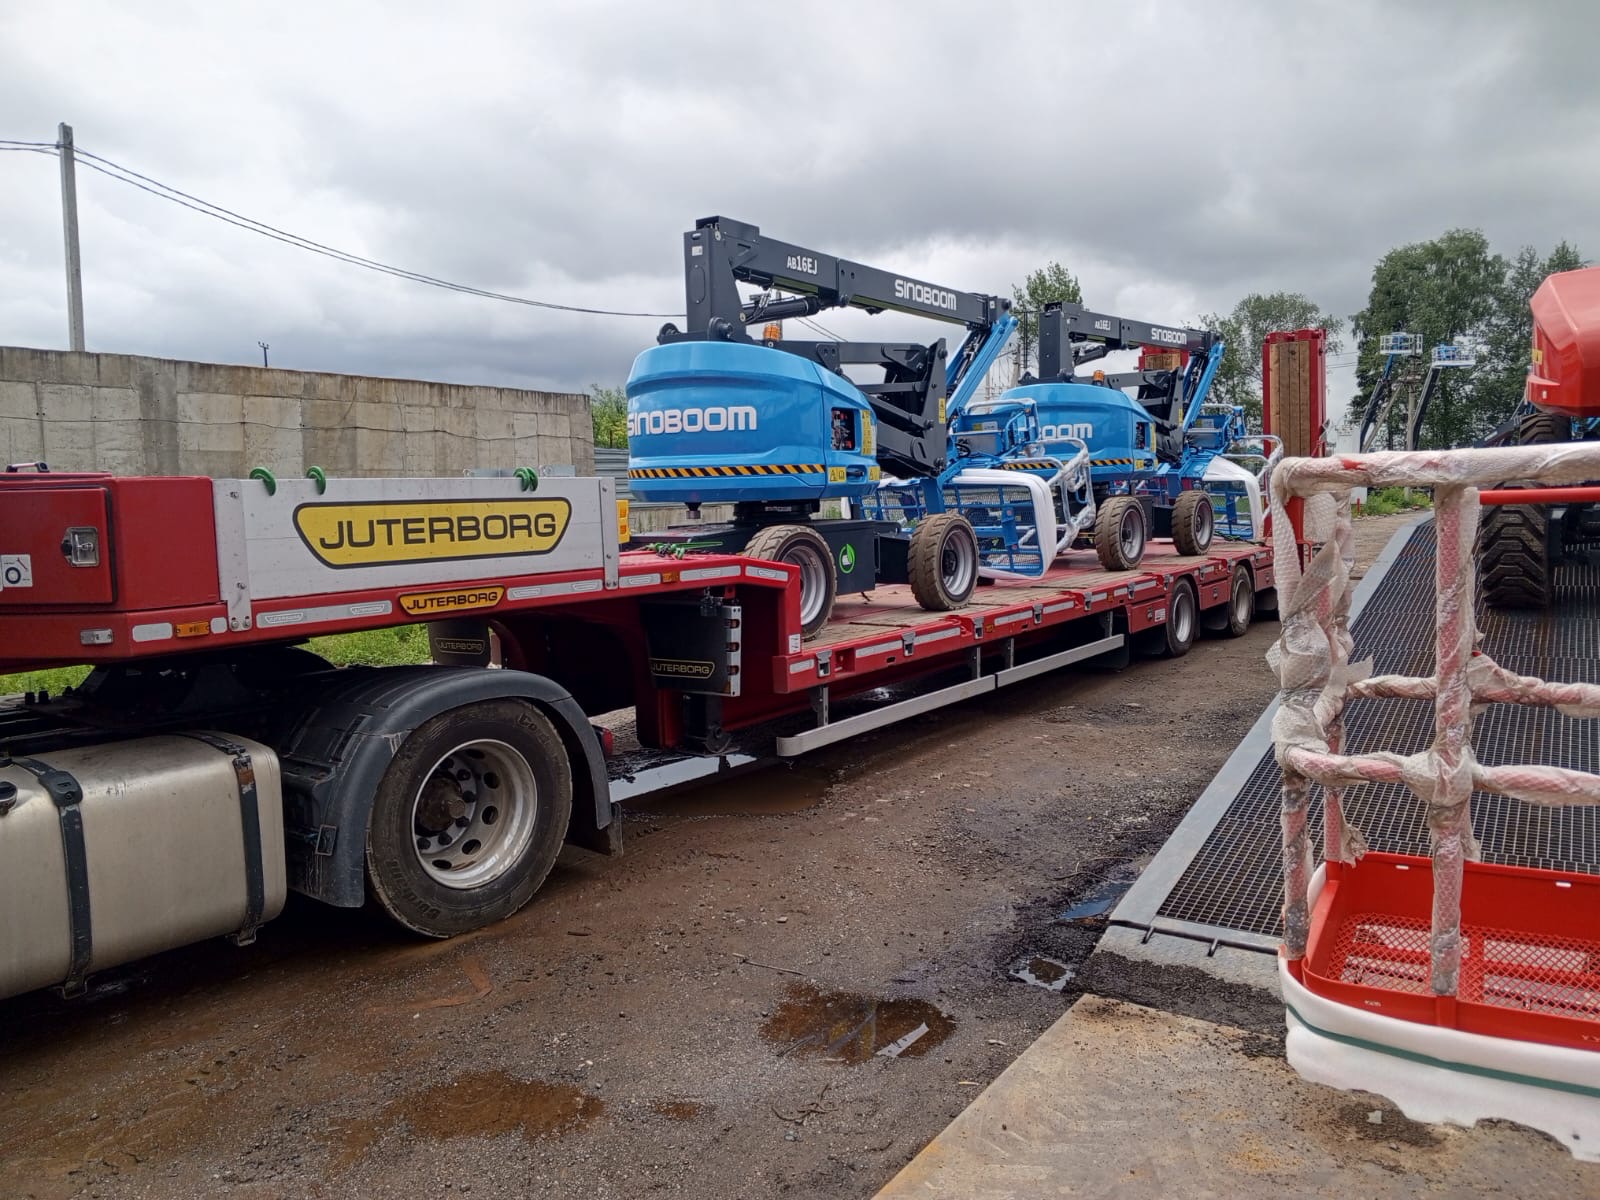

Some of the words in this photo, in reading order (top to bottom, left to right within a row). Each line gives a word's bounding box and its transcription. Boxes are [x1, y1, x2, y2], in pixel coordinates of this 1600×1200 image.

[786, 255, 818, 275] AB16EJ
[894, 279, 957, 311] SINOBOOM
[1151, 327, 1187, 345] SINOBOOM
[627, 406, 757, 437] SINOBOOM
[319, 513, 556, 550] JUTERBORG
[407, 591, 498, 610] JUTERBORG
